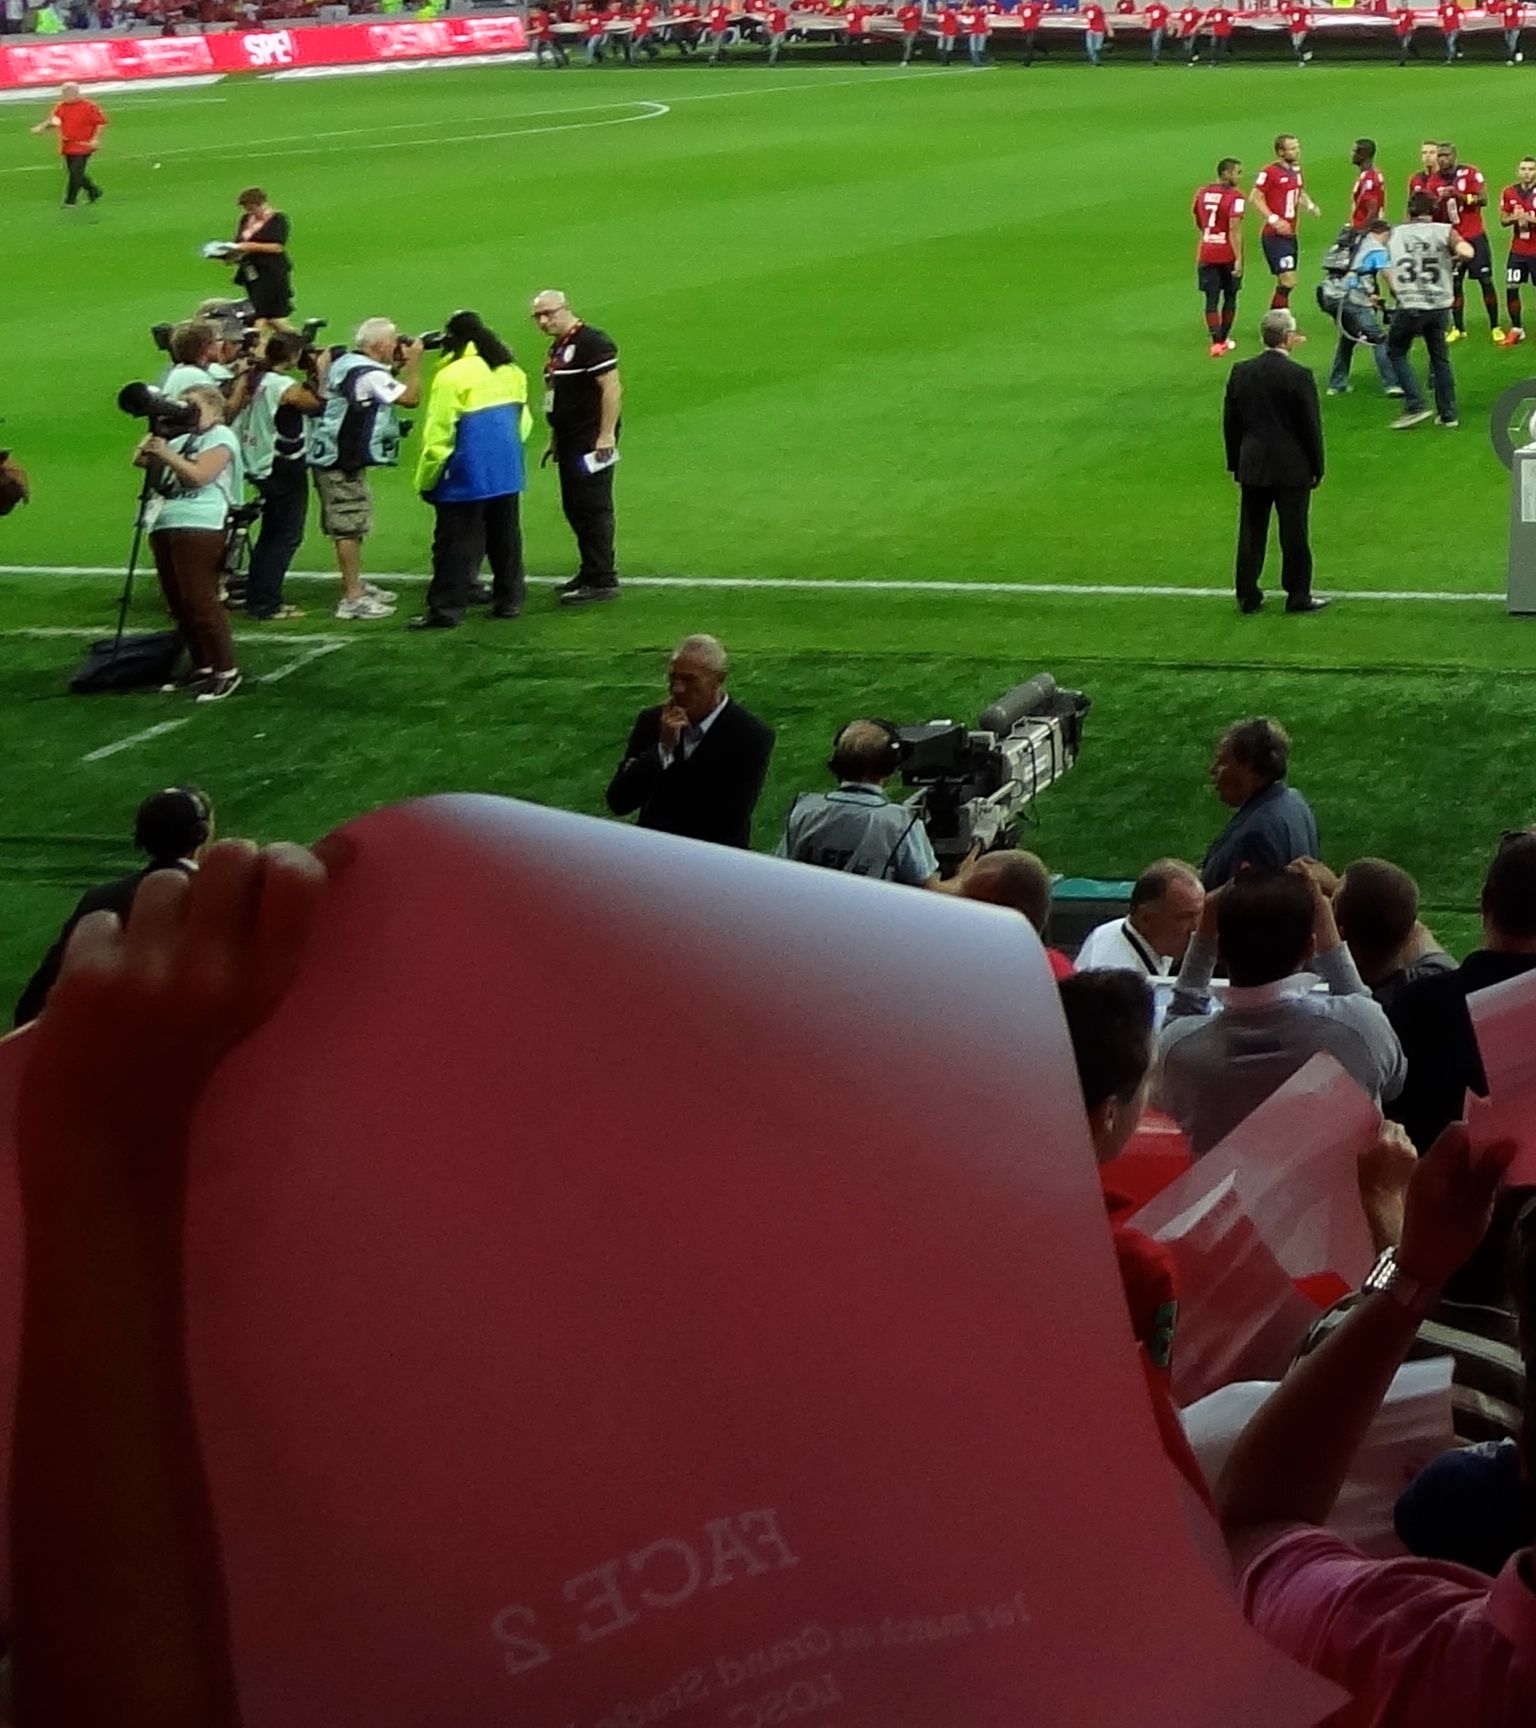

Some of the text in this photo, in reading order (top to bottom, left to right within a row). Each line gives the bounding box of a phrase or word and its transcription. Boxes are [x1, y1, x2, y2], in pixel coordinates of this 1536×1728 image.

[1205, 204, 1219, 227] 7
[1396, 257, 1441, 284] 35
[1506, 269, 1521, 282] 10
